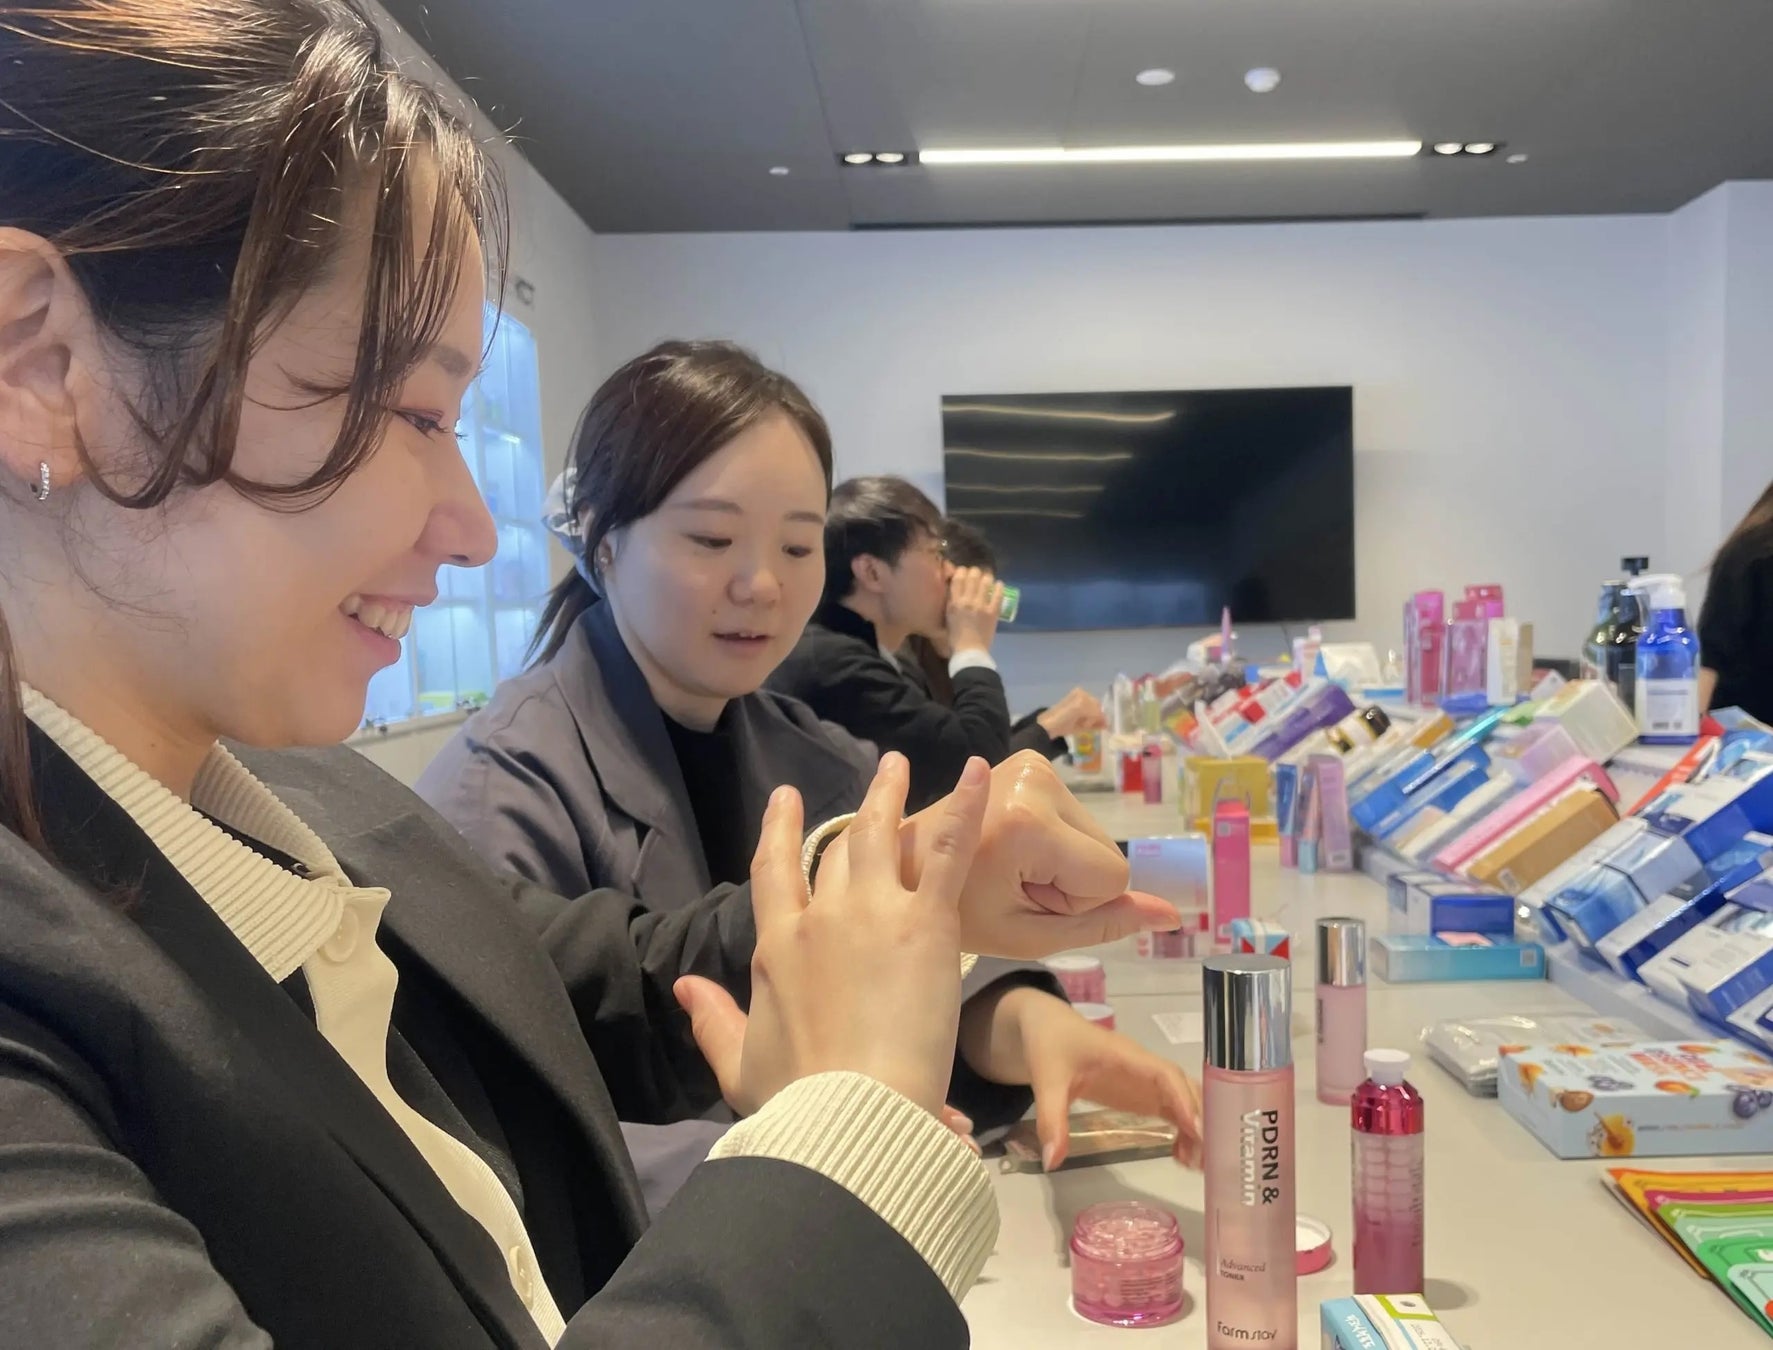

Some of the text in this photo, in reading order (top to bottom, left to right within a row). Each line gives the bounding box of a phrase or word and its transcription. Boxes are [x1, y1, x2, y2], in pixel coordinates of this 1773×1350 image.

[1241, 1109, 1261, 1206] Vitamin
[1261, 1110, 1280, 1205] PDRN &
[1220, 1258, 1266, 1272] Advanced
